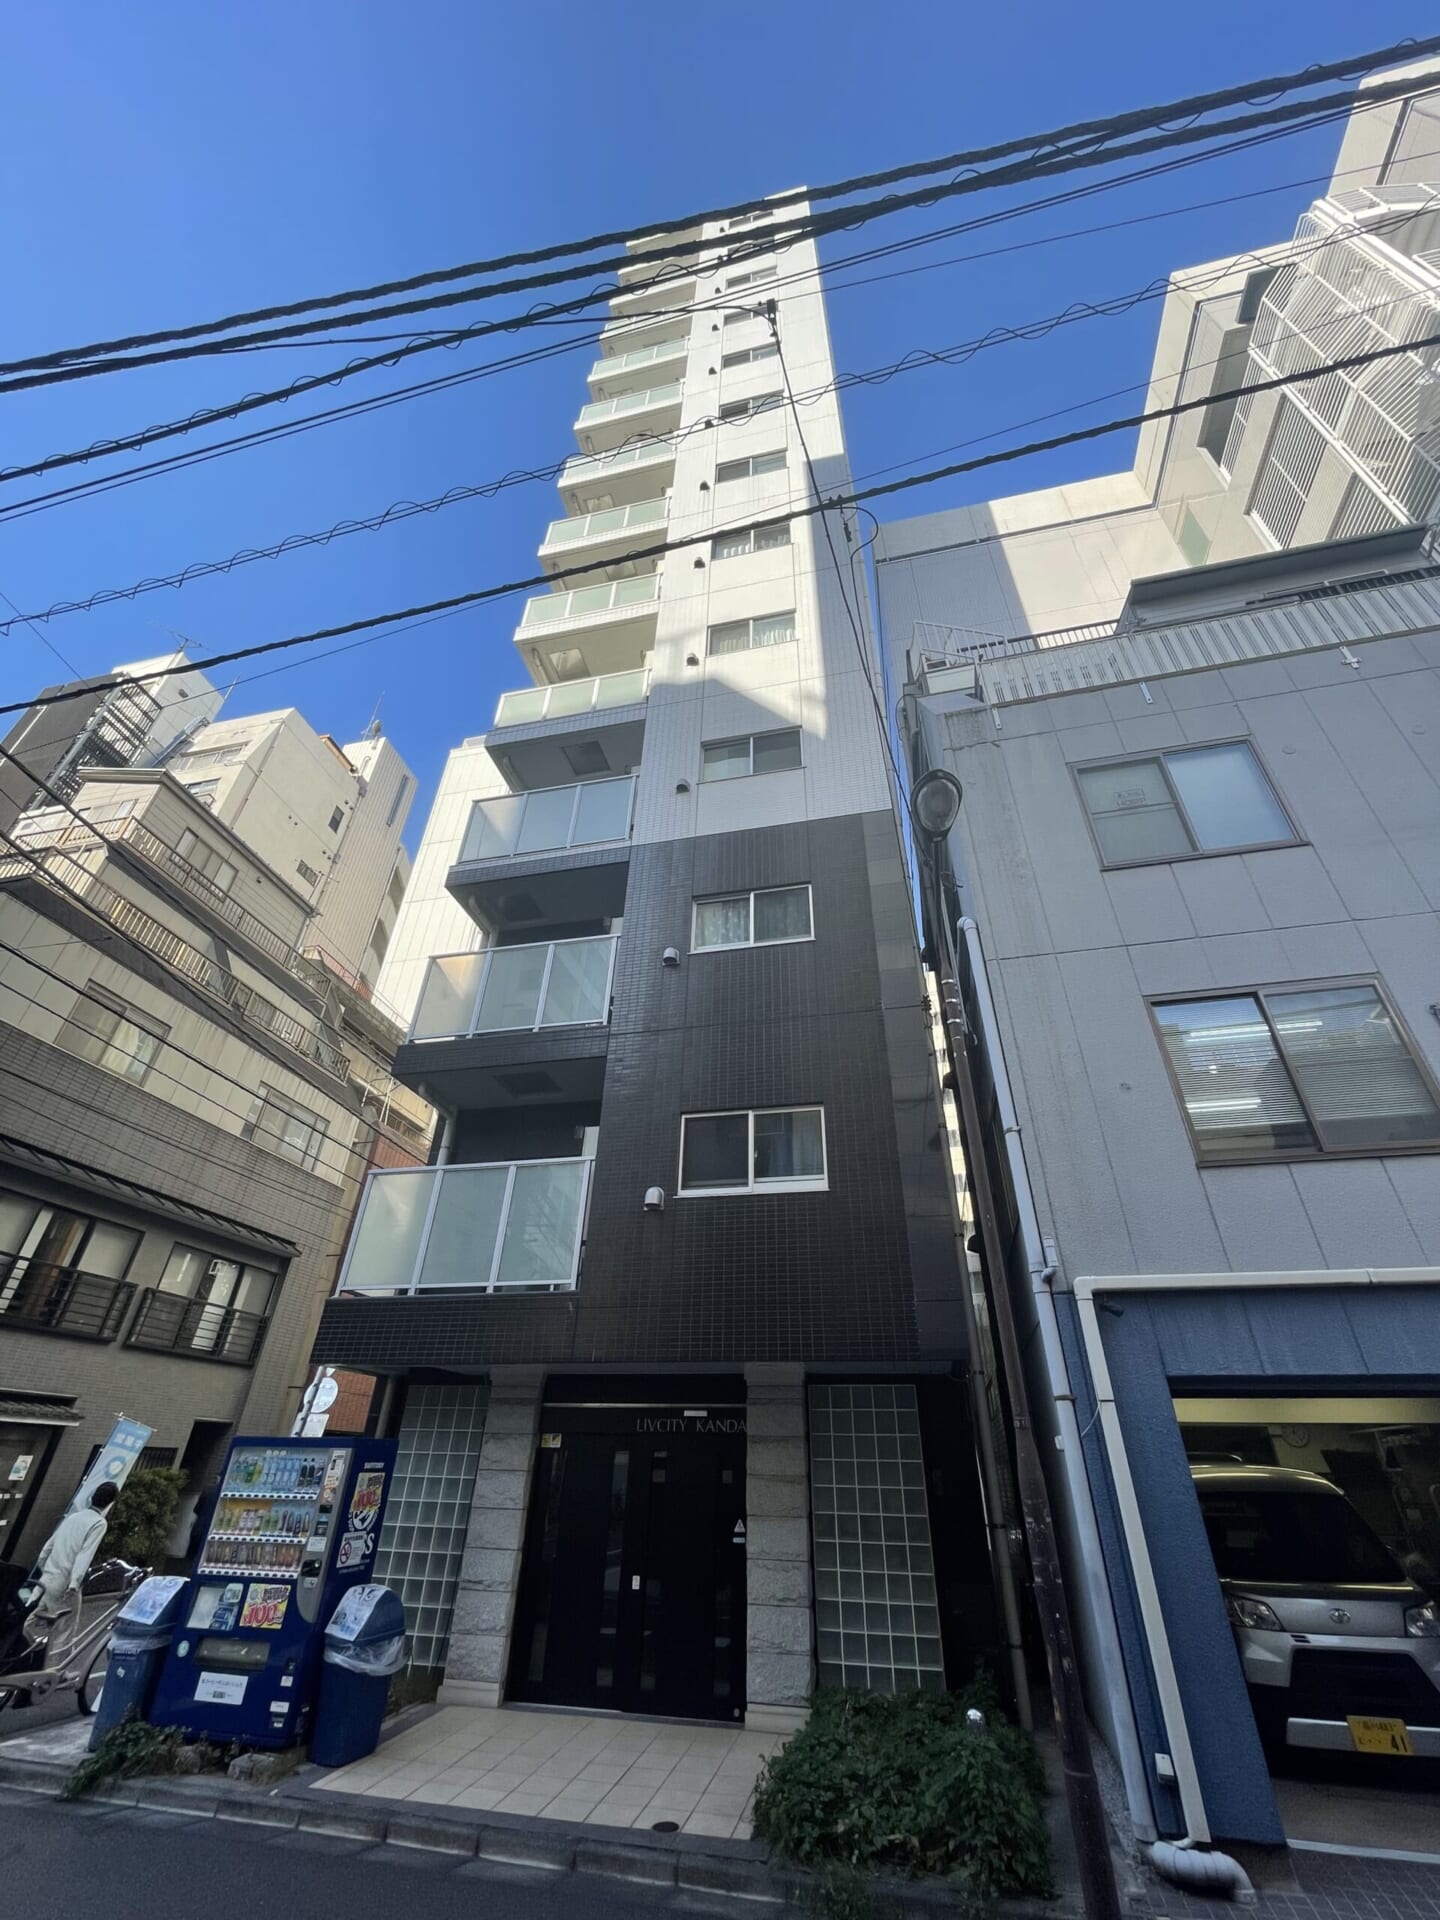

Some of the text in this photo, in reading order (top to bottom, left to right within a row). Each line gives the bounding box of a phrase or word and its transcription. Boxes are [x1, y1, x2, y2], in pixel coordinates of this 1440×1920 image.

[636, 1418, 747, 1432] LIVCITY KANDA
[244, 1602, 278, 1625] 100
[1391, 1734, 1408, 1753] 41
